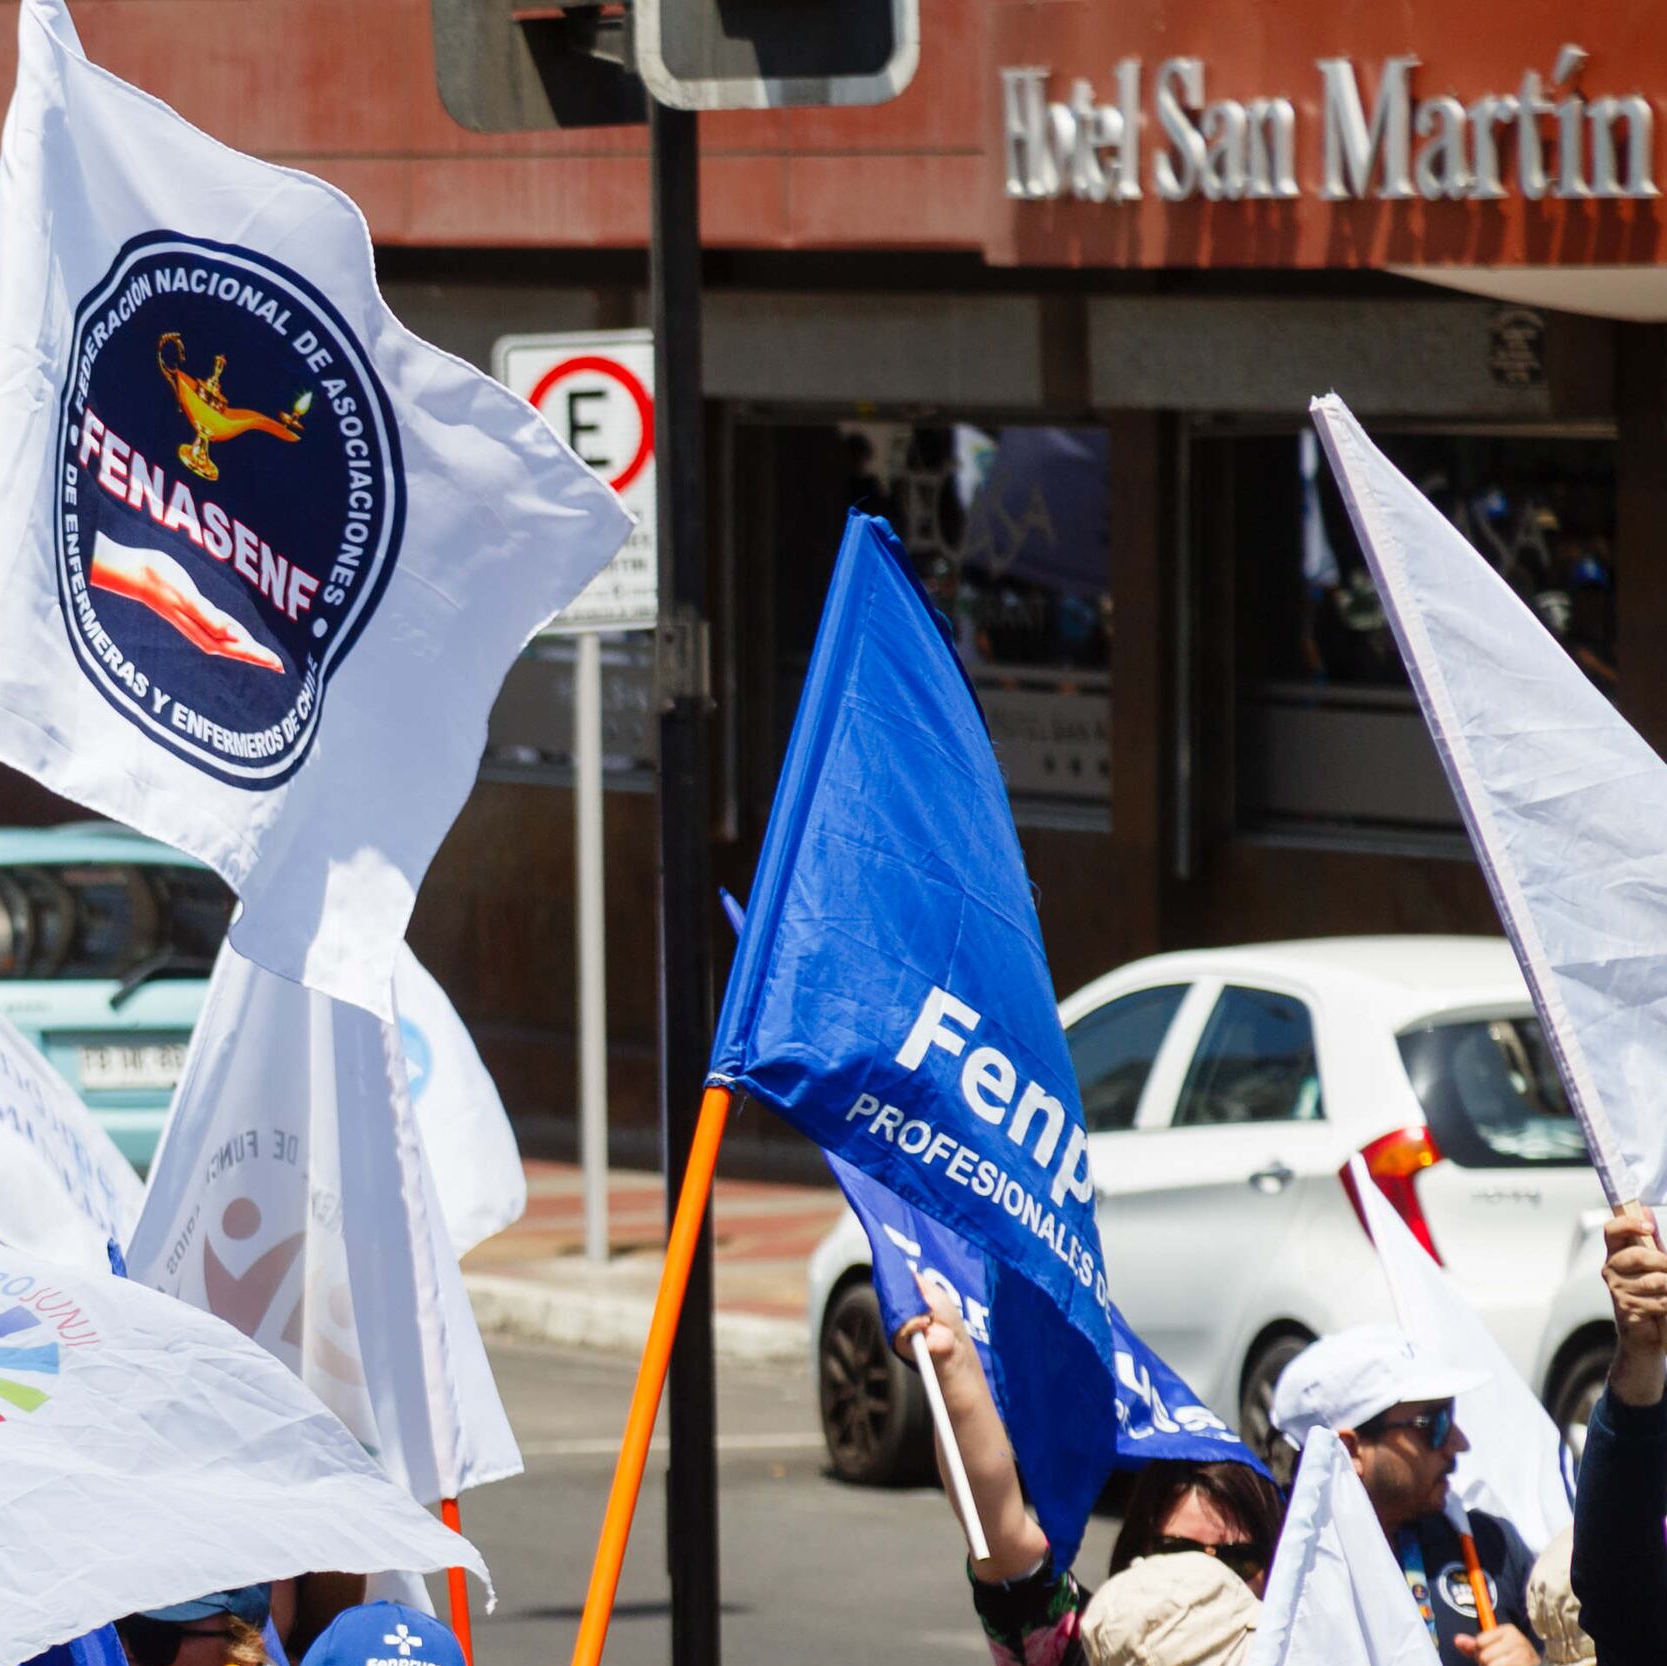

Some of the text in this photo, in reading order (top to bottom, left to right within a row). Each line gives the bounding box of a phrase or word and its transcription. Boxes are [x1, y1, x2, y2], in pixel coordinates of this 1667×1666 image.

[999, 43, 1660, 201] Hotel San Martín
[65, 463, 78, 506] DE
[75, 267, 373, 606] FEDERACIÓN NACIONAL DE ASOCIACIONES
[567, 390, 610, 468] E
[78, 407, 319, 621] FENASENF
[65, 513, 150, 698] ENFERMERAS
[152, 689, 172, 714] Y
[172, 705, 285, 758] ENFERMEROS
[284, 712, 301, 743] DE
[845, 1094, 1095, 1289] PROFESIONALES
